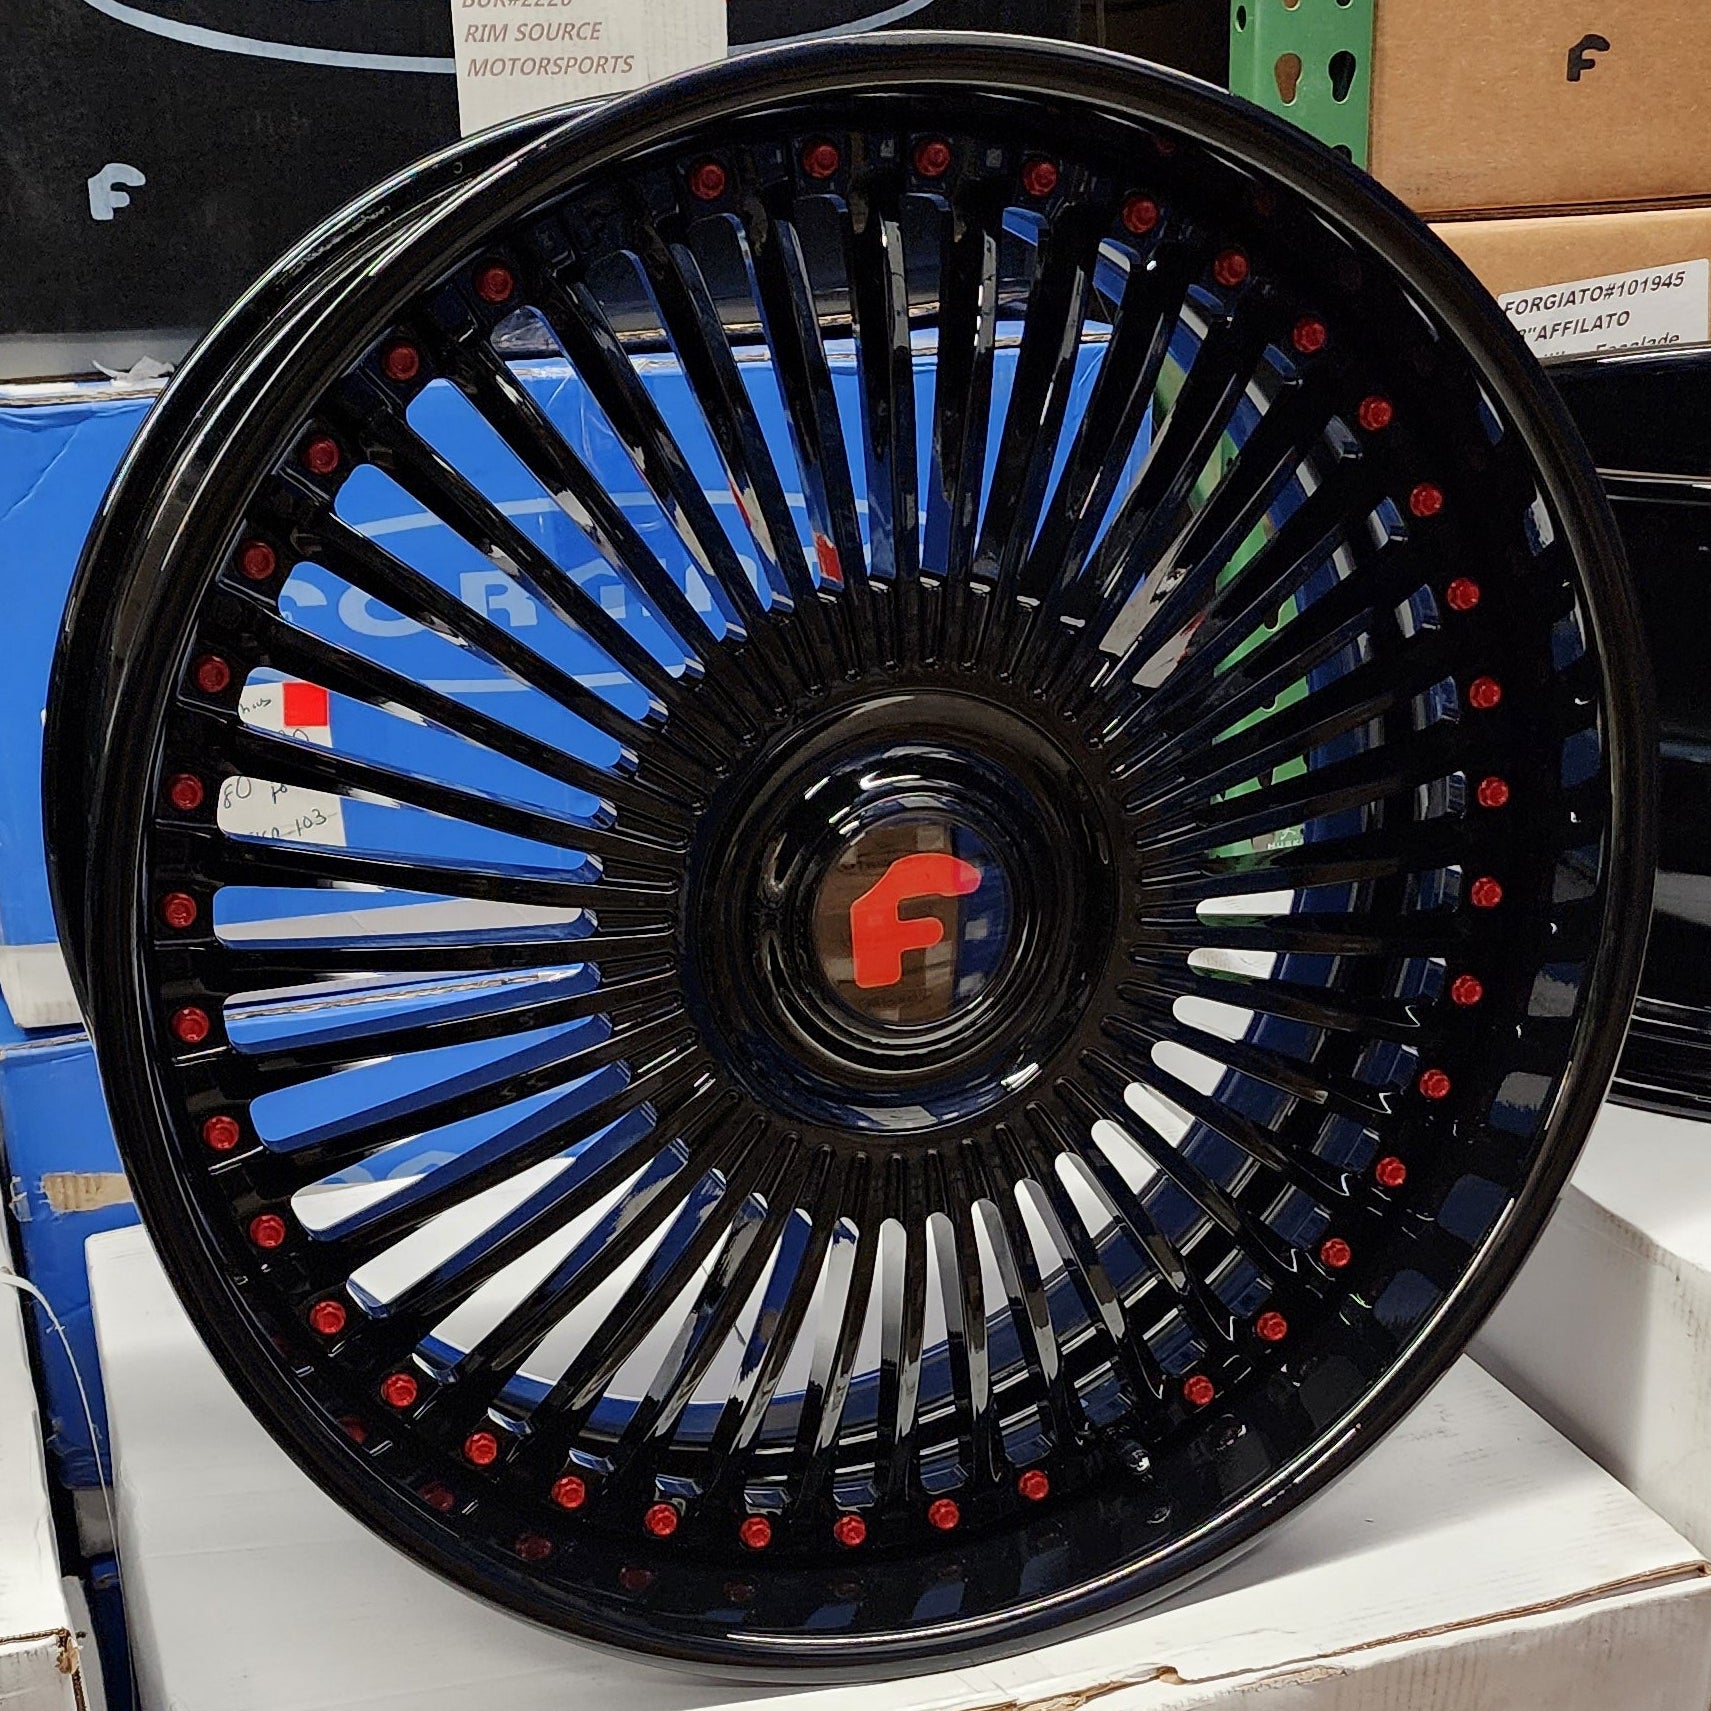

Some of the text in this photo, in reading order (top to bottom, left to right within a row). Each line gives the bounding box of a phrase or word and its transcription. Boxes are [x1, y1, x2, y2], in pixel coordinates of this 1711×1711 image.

[464, 21, 602, 43] RIM SOURCE
[467, 54, 634, 78] MOTORSPORTS
[1504, 270, 1686, 316] FORGIATO#101945
[850, 852, 983, 989] F
